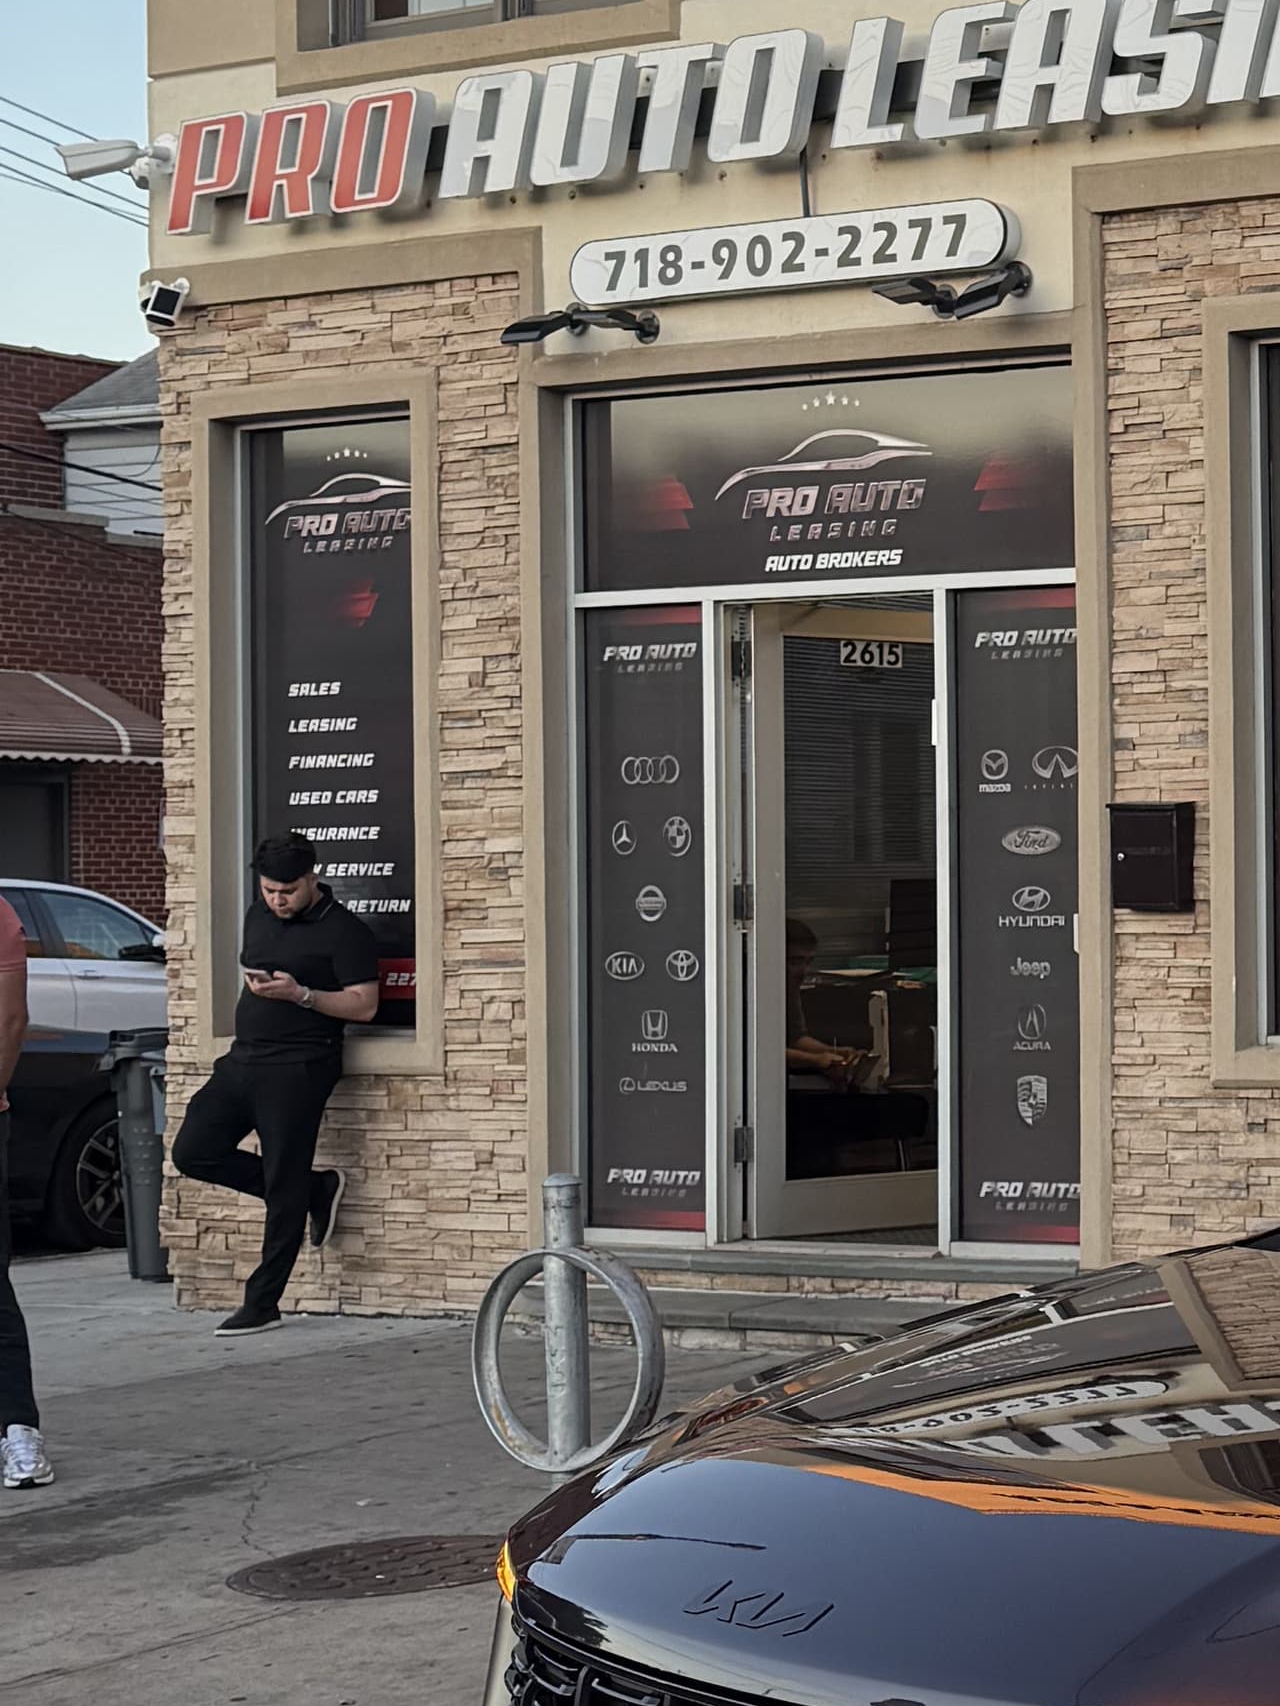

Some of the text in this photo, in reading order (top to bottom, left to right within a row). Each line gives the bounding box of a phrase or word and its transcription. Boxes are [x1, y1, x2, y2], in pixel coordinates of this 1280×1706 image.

[165, 86, 434, 237] PRO
[437, 28, 824, 199] AUTO
[603, 211, 969, 293] 718-902-2277
[742, 478, 927, 520] PRO AUTO
[284, 507, 412, 539] PRO AUTO
[769, 518, 898, 542] LEASING
[303, 535, 394, 554] LEASING
[765, 548, 904, 573] AUTO BROKERS
[975, 627, 1078, 649] PRO AUTO
[602, 641, 698, 663] PRO AUTO
[842, 640, 902, 667] 2615
[288, 680, 342, 698] SALES
[288, 717, 358, 734] LEASING
[288, 752, 375, 770] FINANCING
[288, 788, 380, 806] USED CARS
[289, 825, 381, 841] SURANCE
[1013, 829, 1050, 851] Ford
[325, 862, 395, 877] SERVICE
[346, 898, 412, 913] RETURN
[998, 914, 1066, 928] HYUNDAI
[611, 957, 639, 974] KIA
[1010, 956, 1052, 980] Jeep
[631, 1042, 679, 1053] HONDA
[1012, 1041, 1052, 1051] ACURA
[636, 1079, 688, 1092] LEXUS
[607, 1167, 702, 1186] PRO AUTO
[979, 1181, 1080, 1199] PRO AUTO
